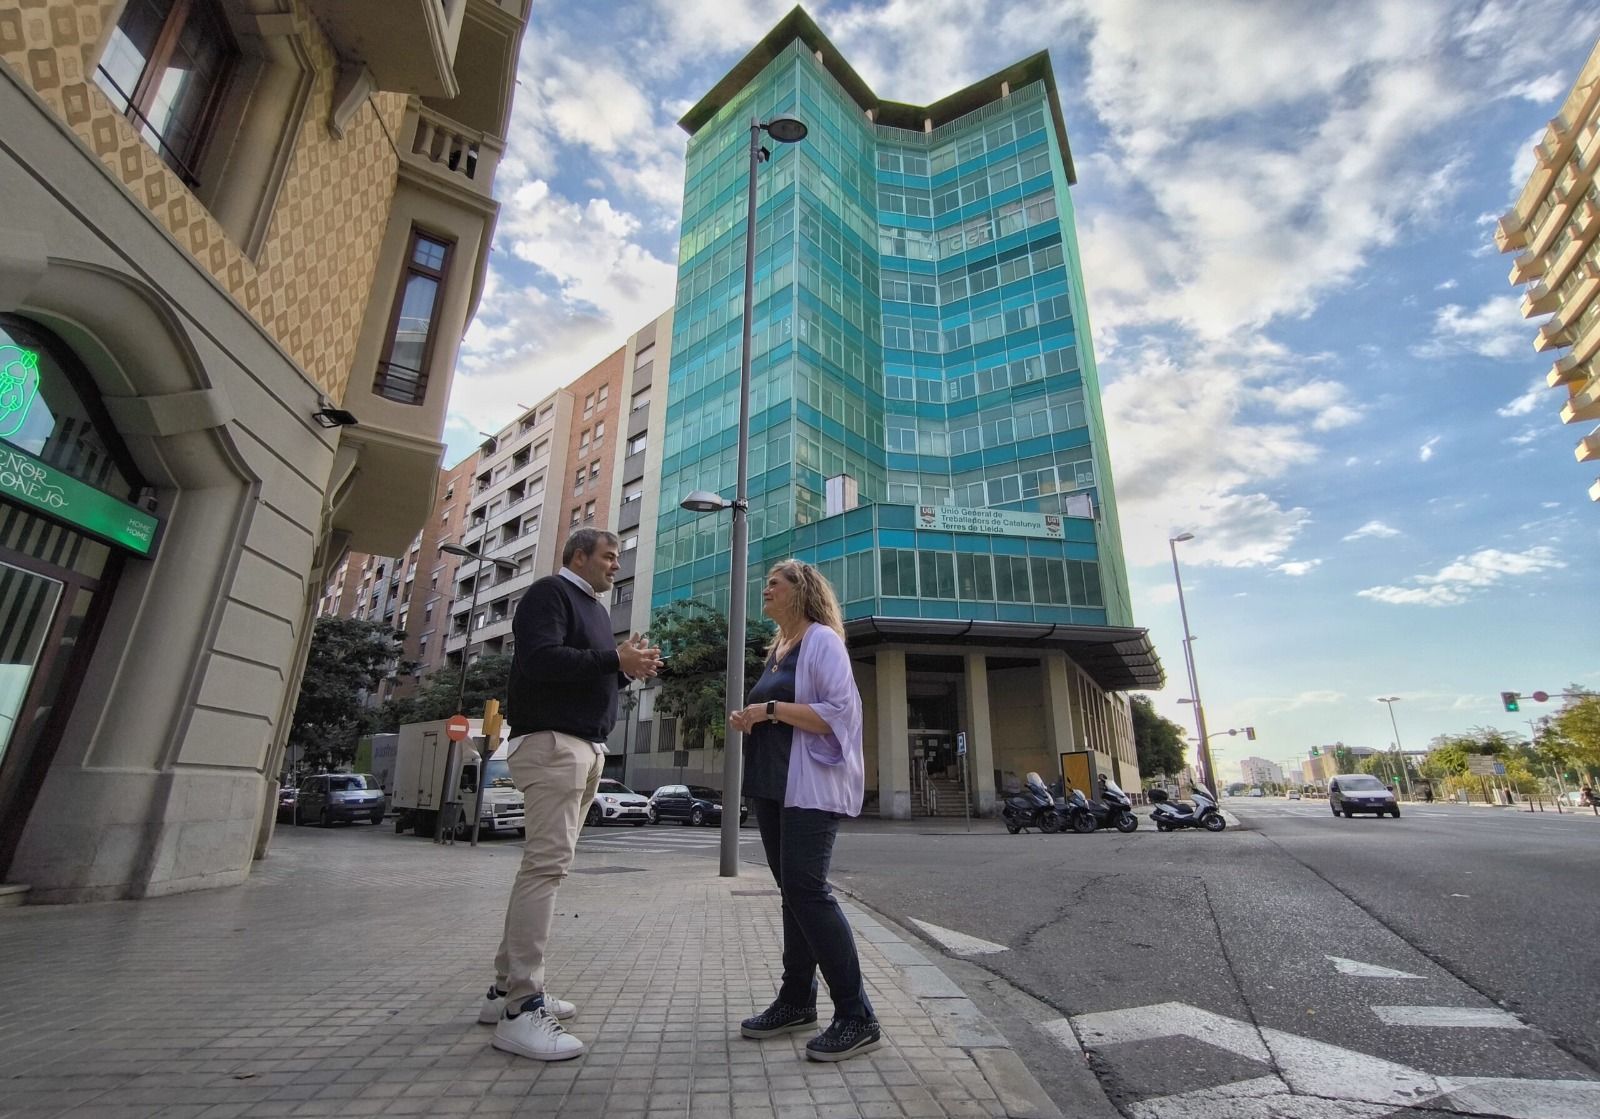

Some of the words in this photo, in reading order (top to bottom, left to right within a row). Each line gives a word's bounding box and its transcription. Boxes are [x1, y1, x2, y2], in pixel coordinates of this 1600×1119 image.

[951, 226, 992, 250] CGT
[0, 471, 69, 508] ONEJO
[961, 508, 991, 517] General
[942, 522, 966, 531] Terres
[968, 523, 977, 531] de
[980, 525, 1003, 533] Lleida
[991, 518, 1000, 526] de
[1003, 519, 1041, 529] Catalunya
